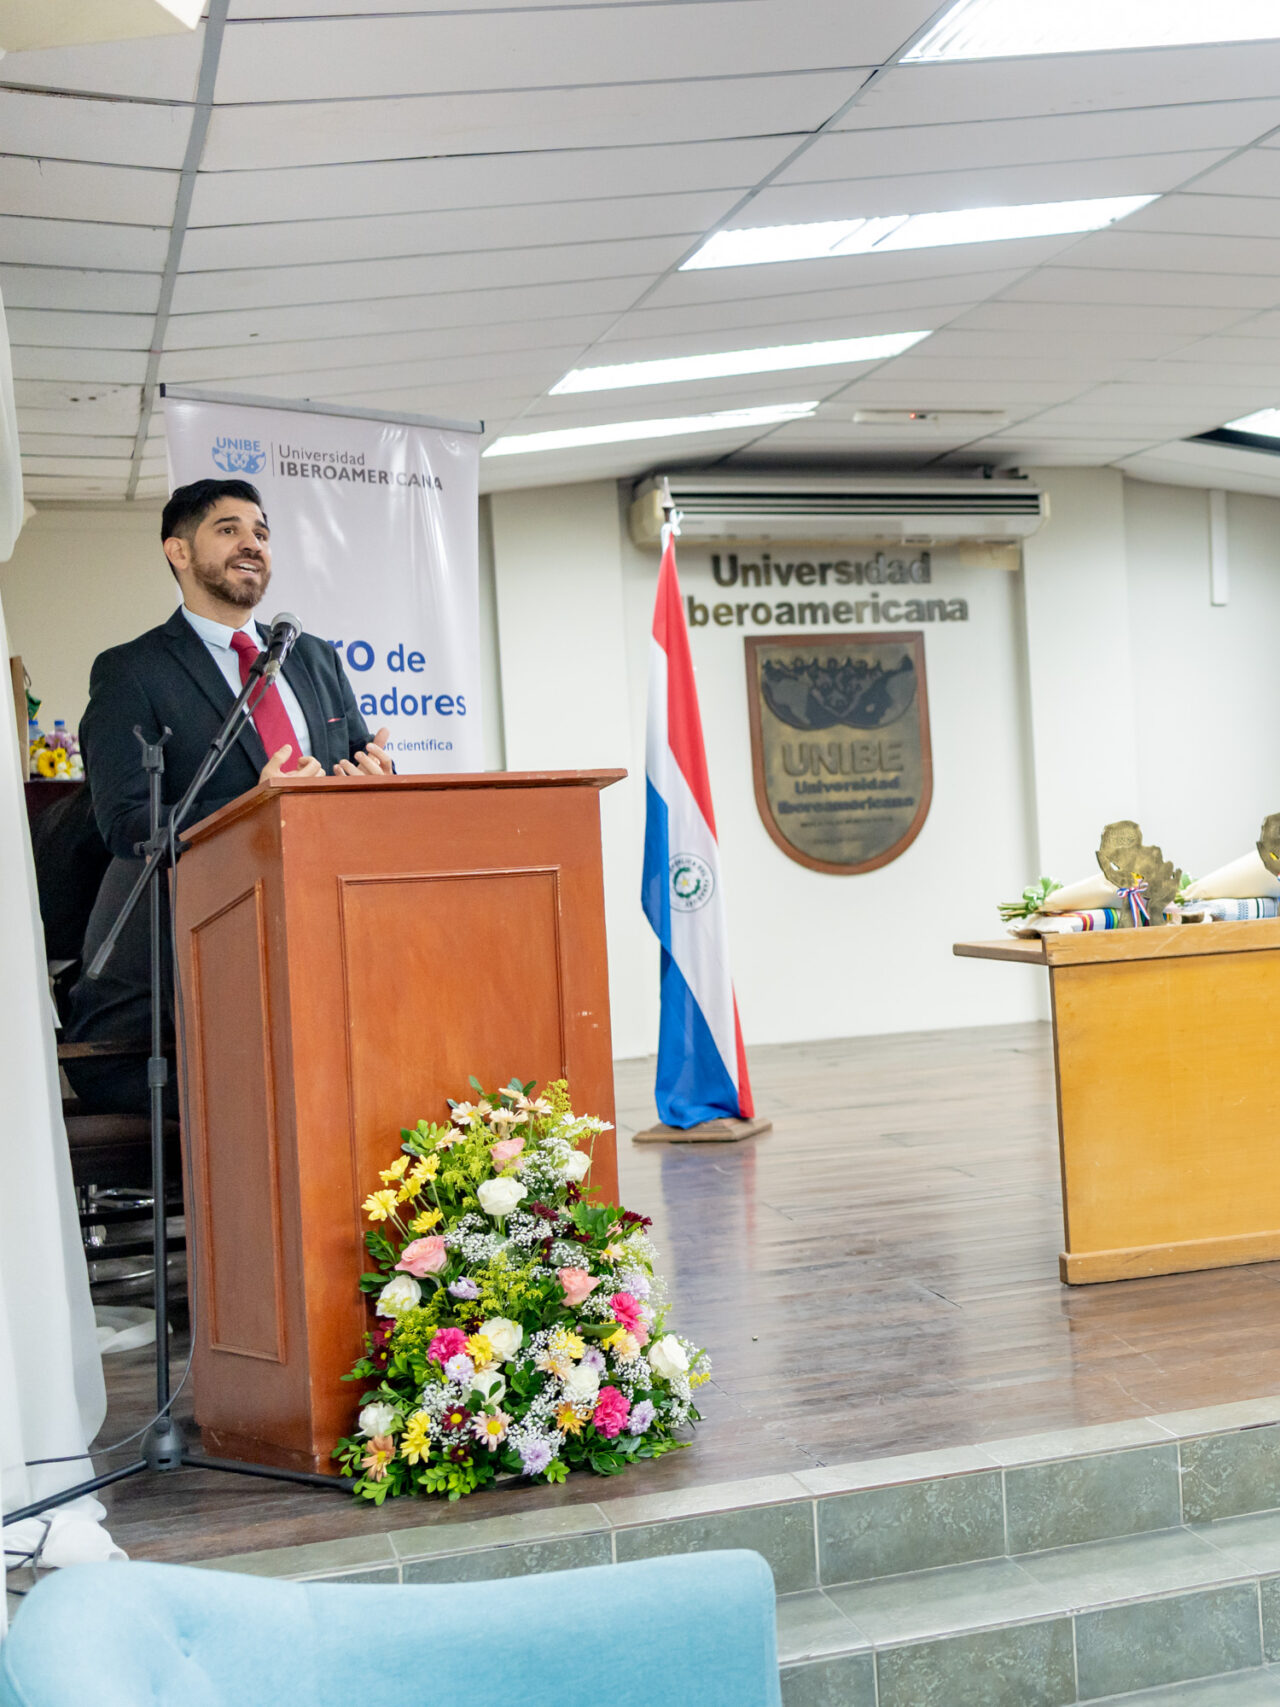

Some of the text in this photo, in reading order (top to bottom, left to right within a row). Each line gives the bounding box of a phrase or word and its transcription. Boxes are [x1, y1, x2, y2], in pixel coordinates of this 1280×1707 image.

[216, 436, 261, 452] UNIBE
[279, 444, 366, 466] Universidad
[711, 552, 932, 587] Universidad
[682, 592, 969, 628] beroamericana
[387, 643, 426, 673] de
[360, 687, 467, 716] adores
[397, 739, 453, 751] científica
[782, 739, 905, 777] UNIBE
